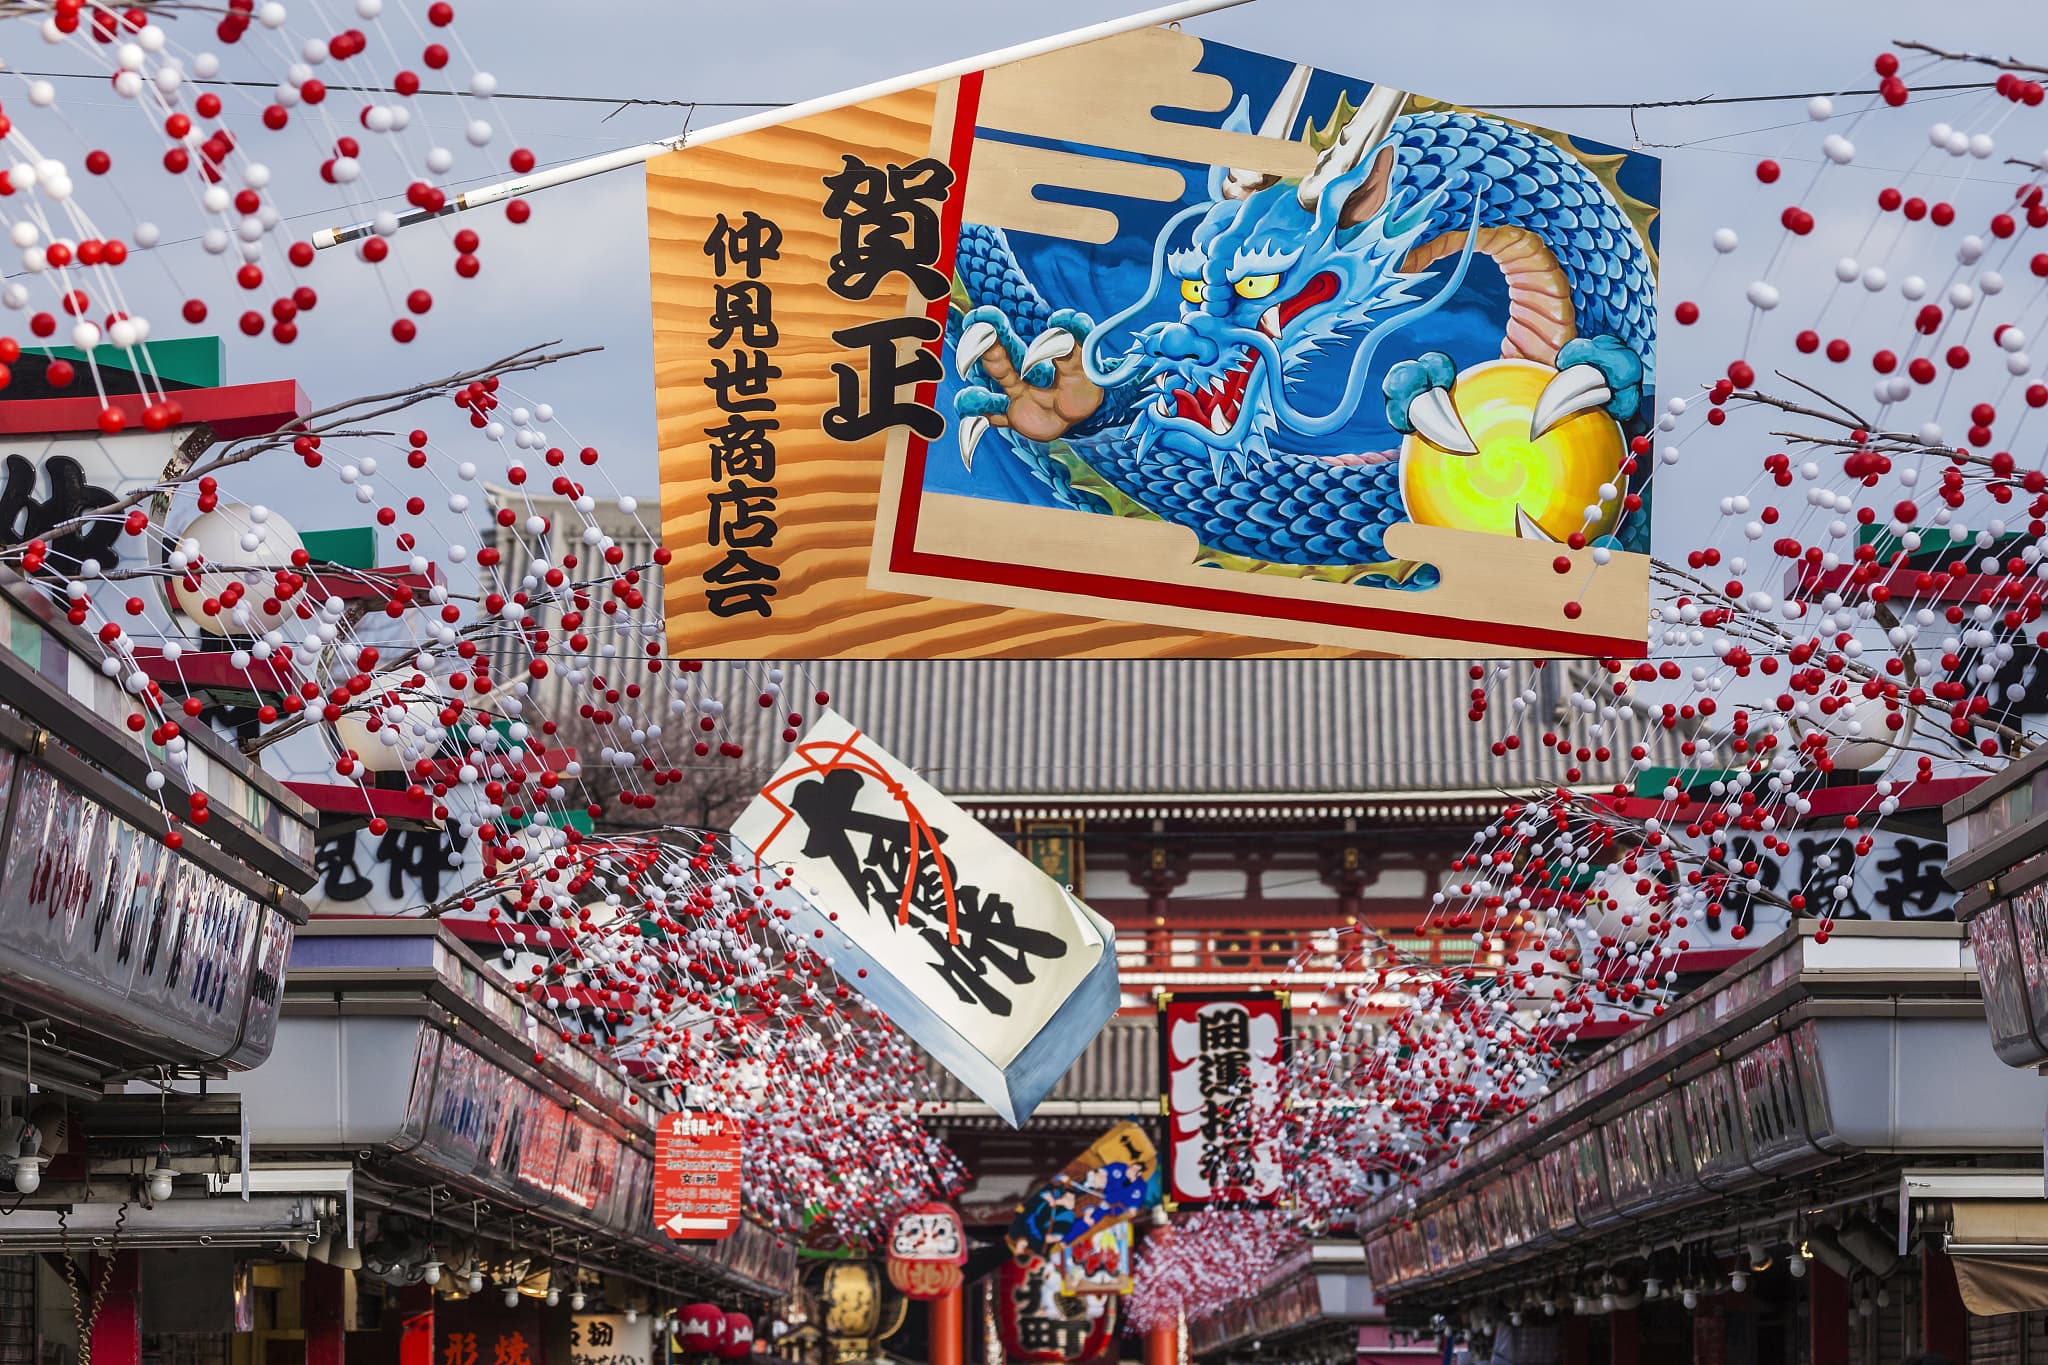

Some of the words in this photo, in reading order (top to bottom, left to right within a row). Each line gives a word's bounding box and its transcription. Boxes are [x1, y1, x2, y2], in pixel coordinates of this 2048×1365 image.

[702, 210, 784, 619] 仲見世商店会
[822, 154, 956, 442] 賀正
